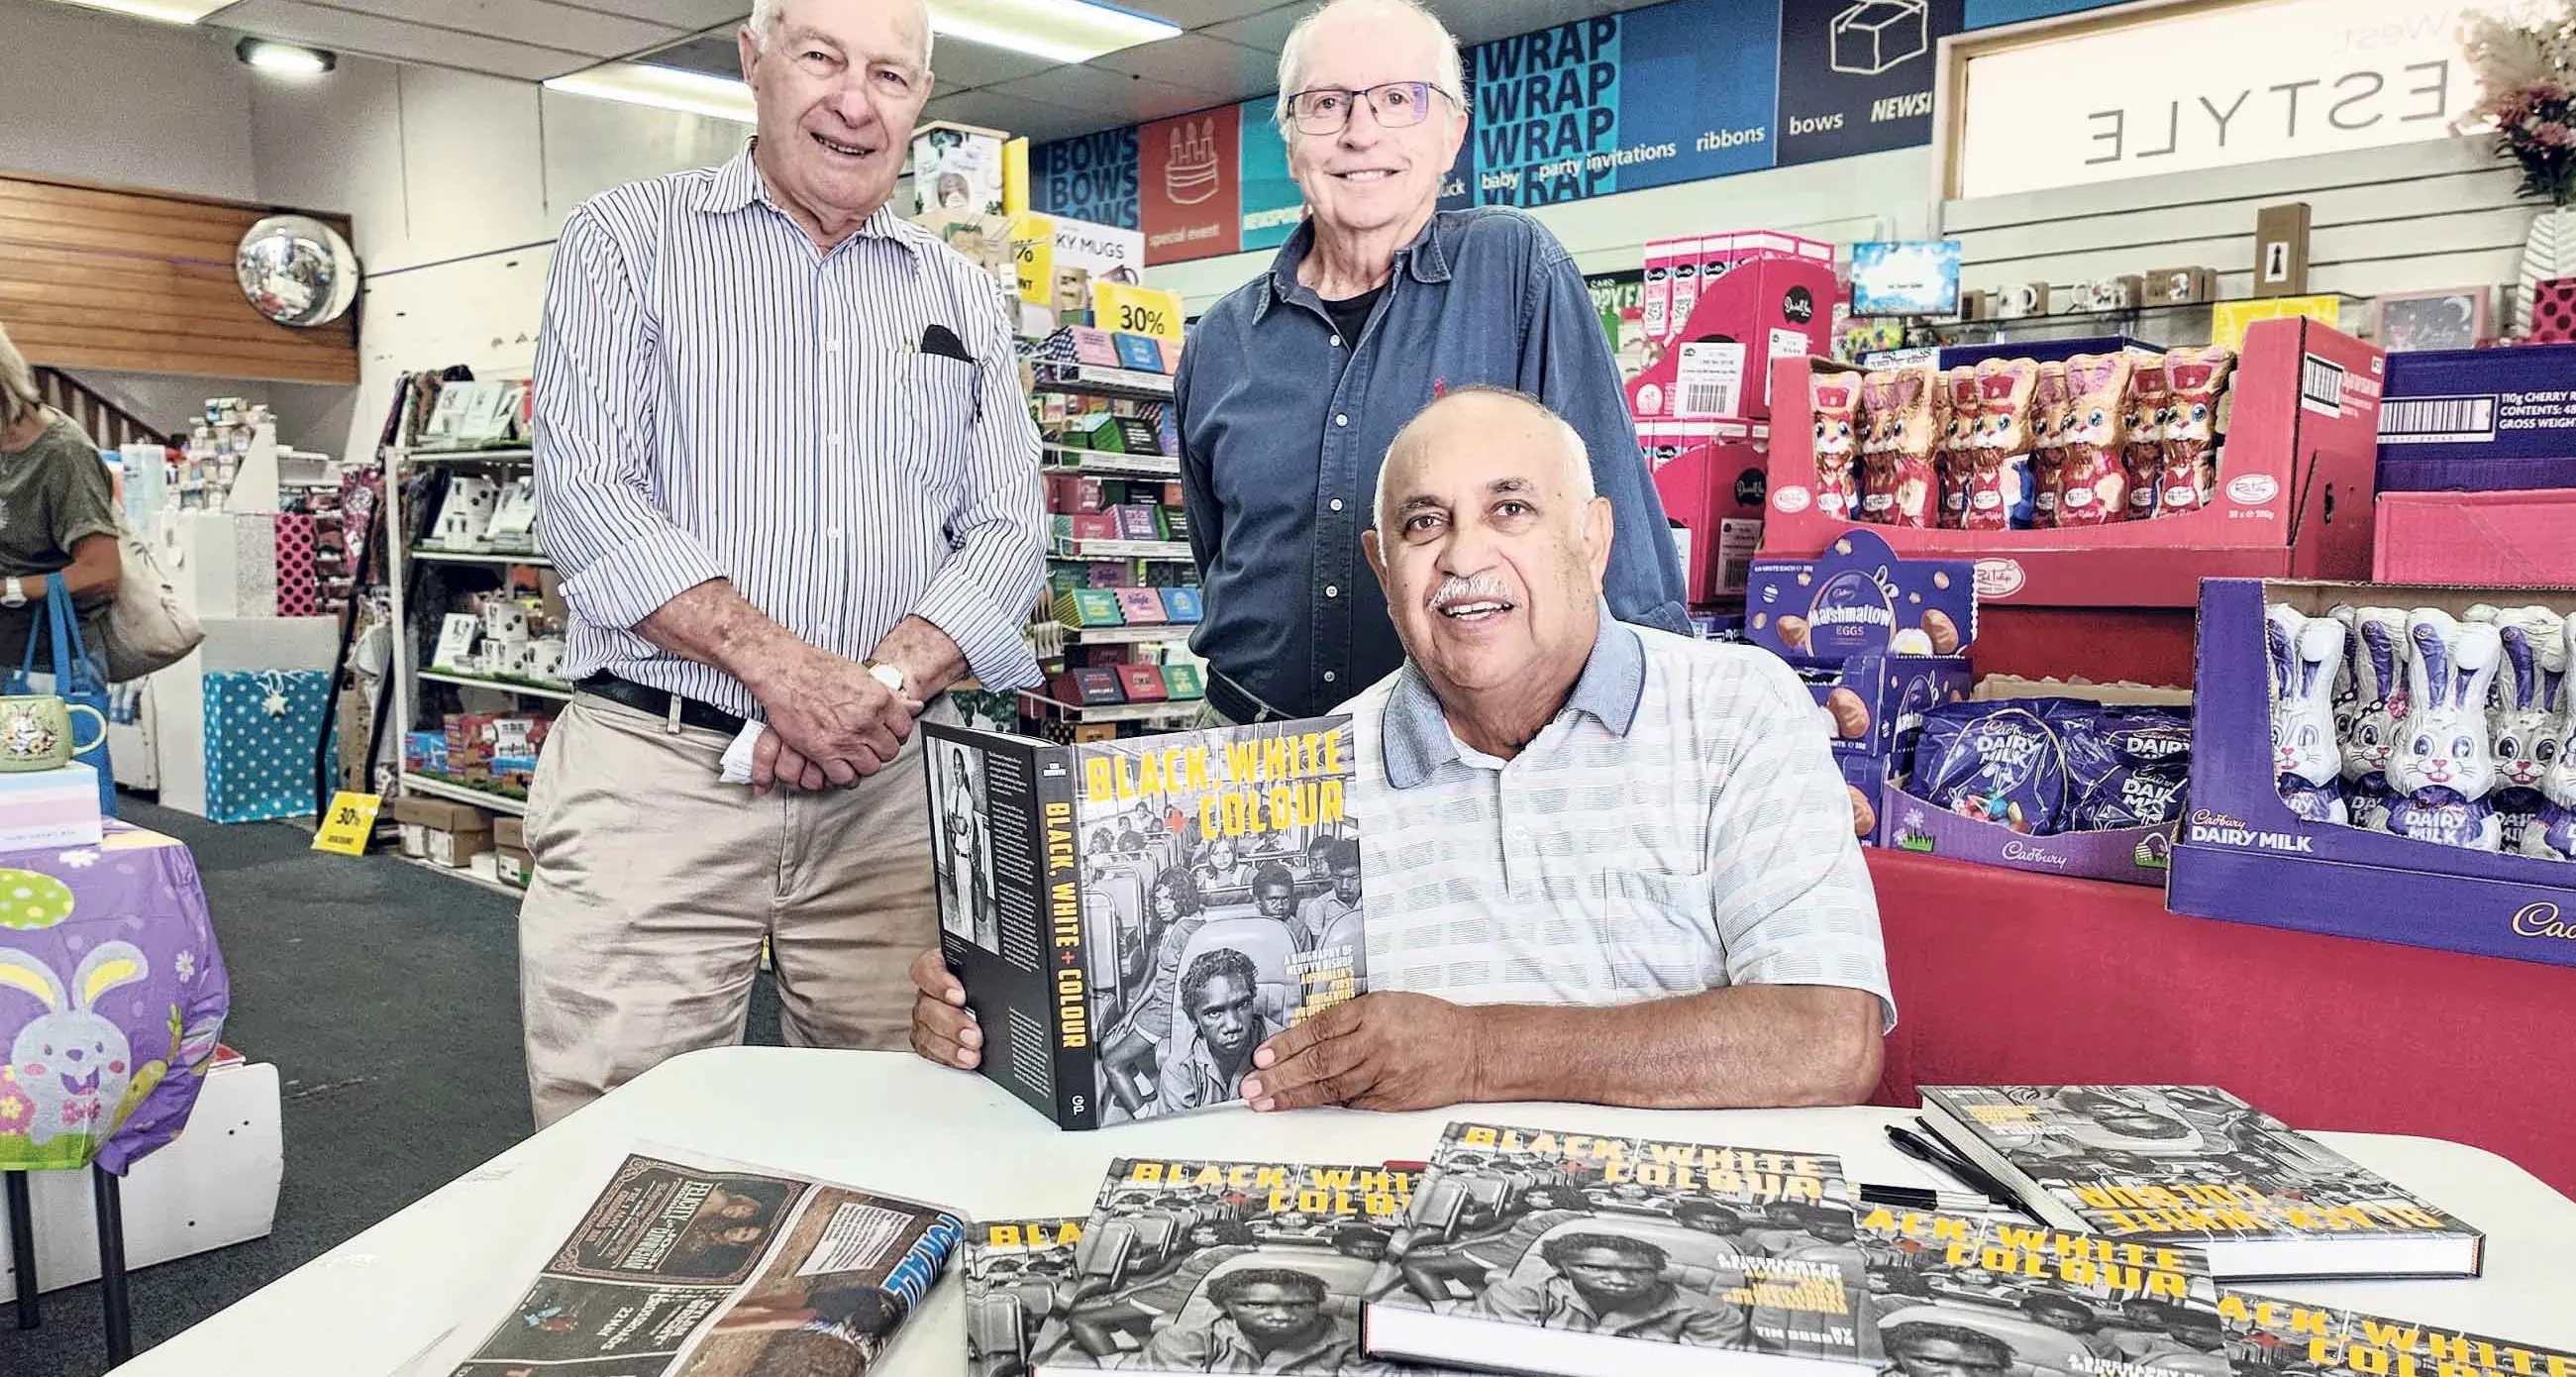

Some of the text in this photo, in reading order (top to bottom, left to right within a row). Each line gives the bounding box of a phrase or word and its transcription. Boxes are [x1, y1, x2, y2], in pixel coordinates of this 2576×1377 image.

[1483, 15, 1617, 82] WRAP
[1481, 61, 1616, 126] WRAP
[1480, 106, 1615, 169] WRAP
[1789, 112, 1843, 136] bows
[1051, 128, 1137, 174] BOWS
[1696, 126, 1765, 152] ribbons
[1586, 141, 1677, 170] invitations
[1050, 163, 1137, 206] BOWS
[1482, 170, 1520, 190] baby
[1539, 159, 1581, 182] party
[1081, 238, 1125, 260] MUGS
[1148, 224, 1221, 252] special event
[1120, 304, 1166, 335] 30%
[2500, 404, 2562, 416] CONTENTS:
[2501, 392, 2524, 407] 110g
[2524, 391, 2568, 403] CHERRY
[2499, 417, 2536, 429] GROSS
[1808, 603, 1892, 628] Marshmallow
[1835, 625, 1865, 637] EGGS
[1225, 729, 1341, 786] WHITE
[1977, 734, 2040, 754] DAIRY
[1198, 779, 1345, 840] COLOUR
[2191, 808, 2247, 831] Cadbury
[2404, 811, 2467, 829] DAIRY
[1046, 802, 1075, 877] BLACK,
[2191, 824, 2314, 853] DAIRY MILK
[2001, 840, 2068, 869] Cadbury
[1052, 882, 1081, 948] WHITE
[1058, 968, 1087, 1049] COLOUR
[1650, 1141, 1828, 1175] WHITE
[1603, 1161, 1822, 1199] COLOUR
[2068, 1184, 2267, 1209] COLOUR
[2104, 1207, 2272, 1231] WHITE
[1999, 1226, 2187, 1271] WHITE
[1946, 1242, 2189, 1300] COLOUR
